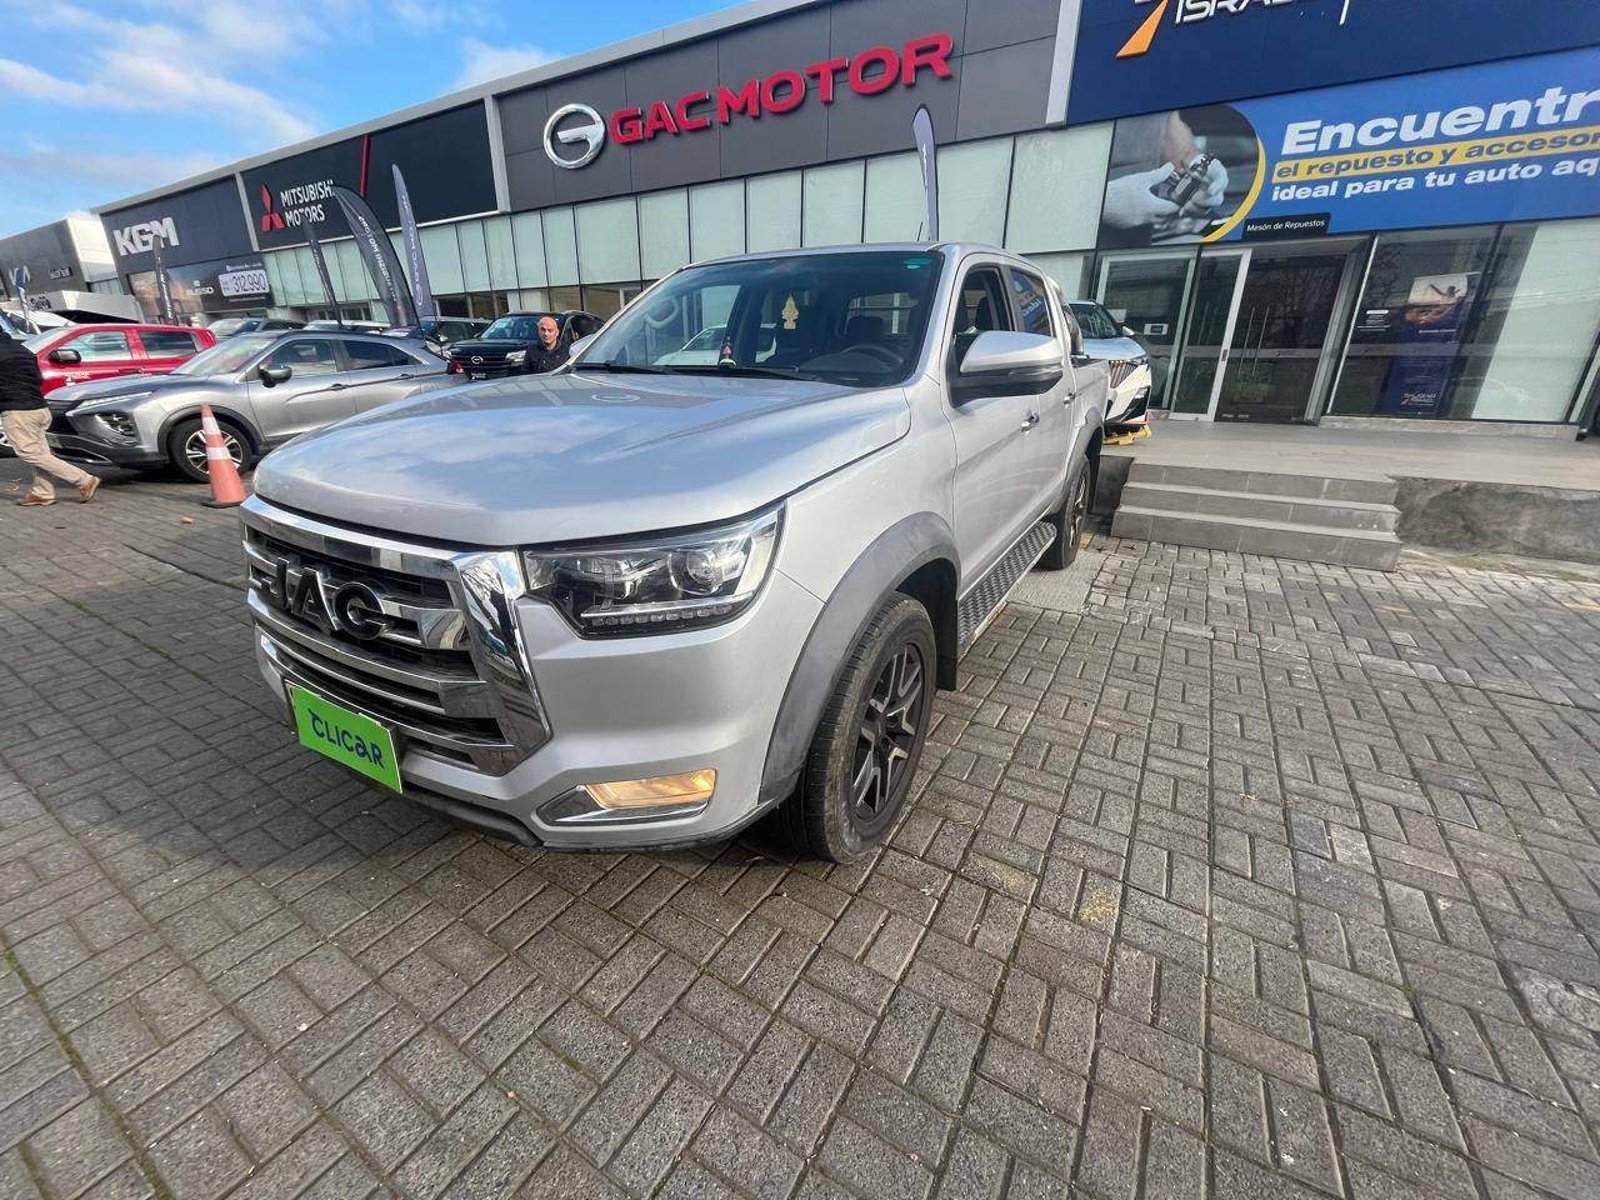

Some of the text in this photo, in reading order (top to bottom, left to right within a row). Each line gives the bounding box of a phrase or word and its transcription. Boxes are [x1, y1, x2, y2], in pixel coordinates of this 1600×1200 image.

[609, 33, 953, 144] GAC MOTOR
[1281, 87, 1600, 154] Encuentr
[1272, 158, 1600, 201] ideal para tu auto aq
[1276, 163, 1299, 178] el
[1306, 148, 1433, 176] repuesto
[1439, 148, 1457, 165] y
[285, 204, 326, 227] MOORS
[1273, 222, 1284, 230] de
[1284, 219, 1326, 230] Repuestos
[261, 557, 388, 641] JAC
